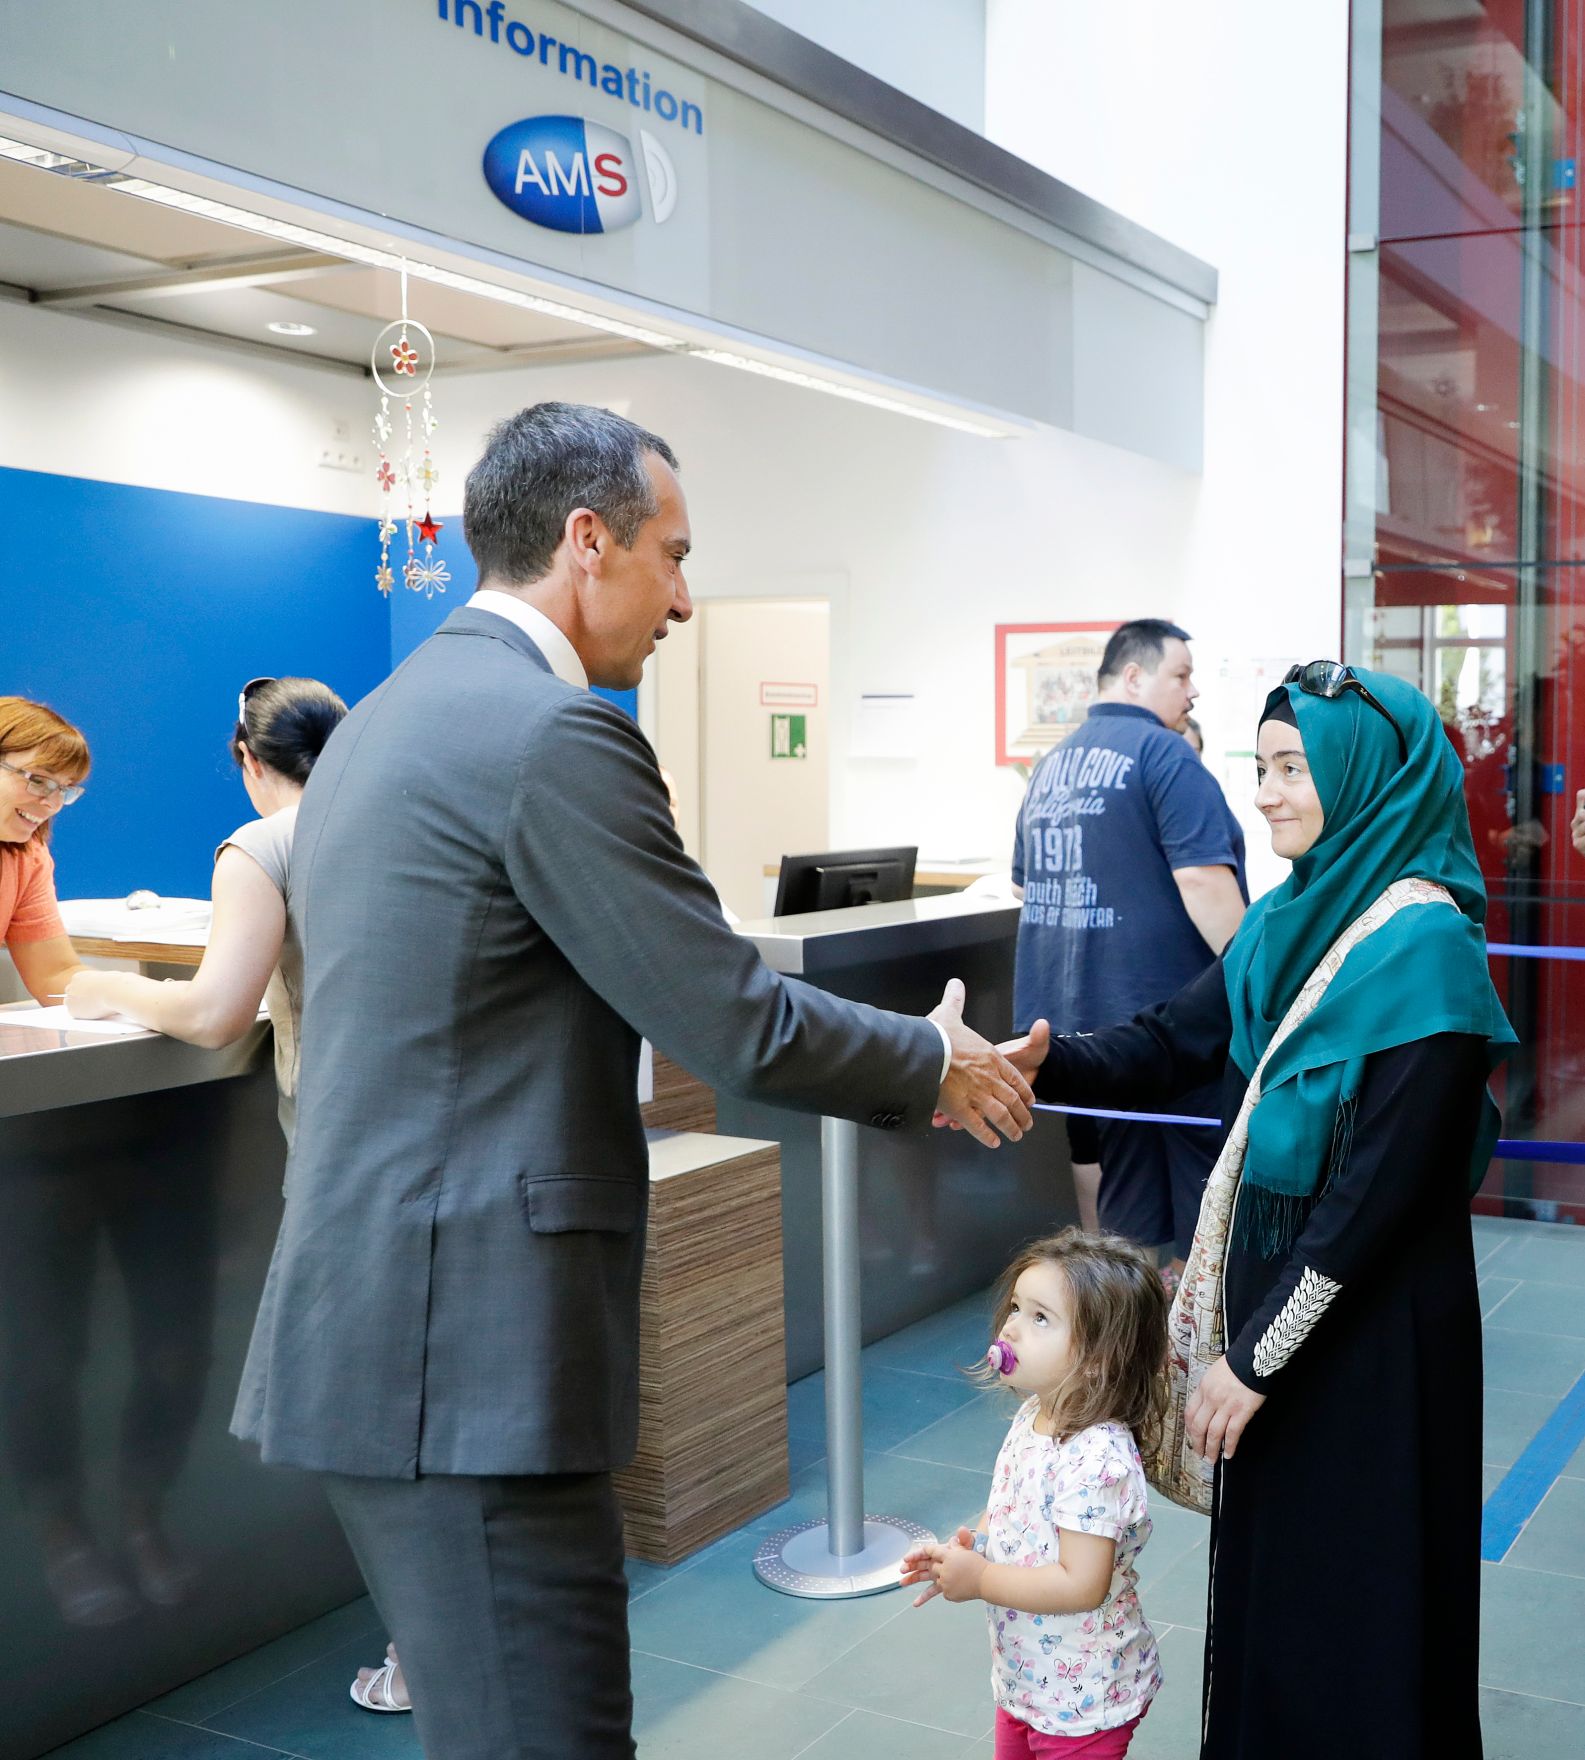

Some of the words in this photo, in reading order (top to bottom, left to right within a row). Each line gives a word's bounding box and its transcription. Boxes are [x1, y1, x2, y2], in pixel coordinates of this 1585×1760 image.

[514, 148, 628, 197] AMS
[1076, 747, 1135, 789] COVE
[1024, 877, 1062, 906] outh
